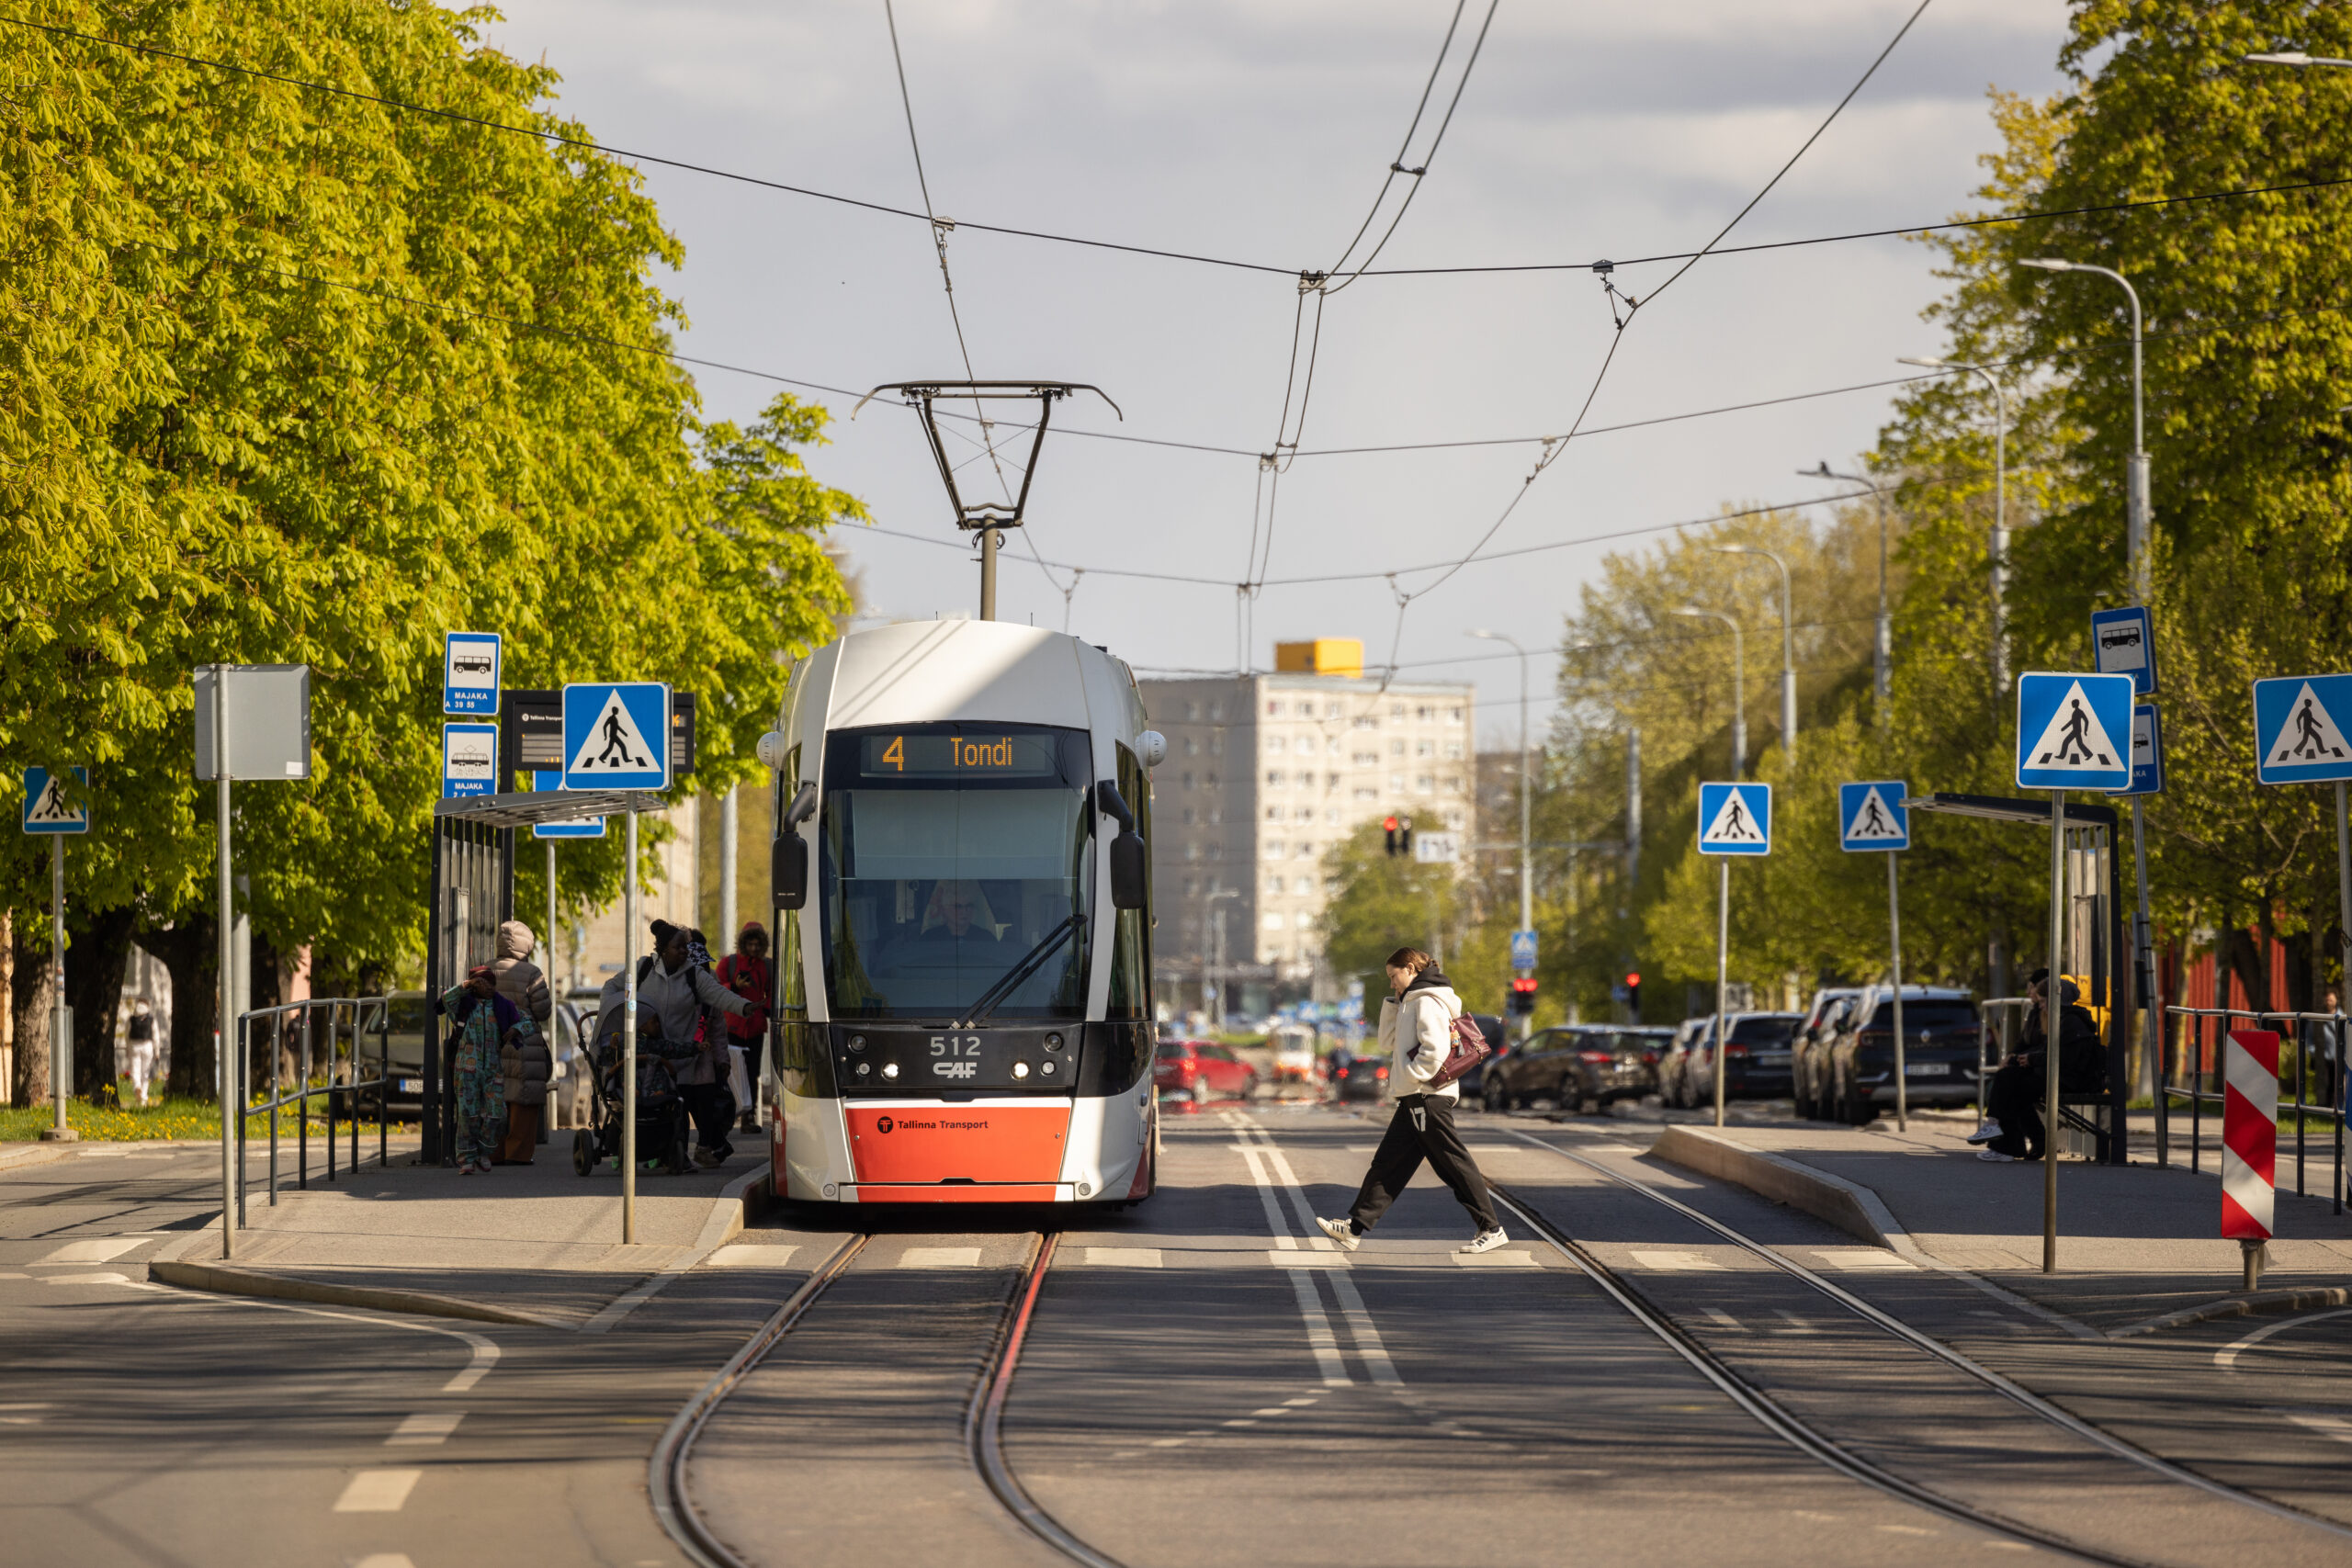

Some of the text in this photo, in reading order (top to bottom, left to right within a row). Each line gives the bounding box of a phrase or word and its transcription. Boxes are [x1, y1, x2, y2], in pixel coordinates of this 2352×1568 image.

[454, 692, 488, 700] MAJAKA
[882, 736, 1012, 772] 4 Tondi
[454, 782, 484, 790] MAJAKA
[930, 1036, 981, 1056] 512
[933, 1062, 978, 1078] CAF
[898, 1120, 989, 1131] Tallinna Transport
